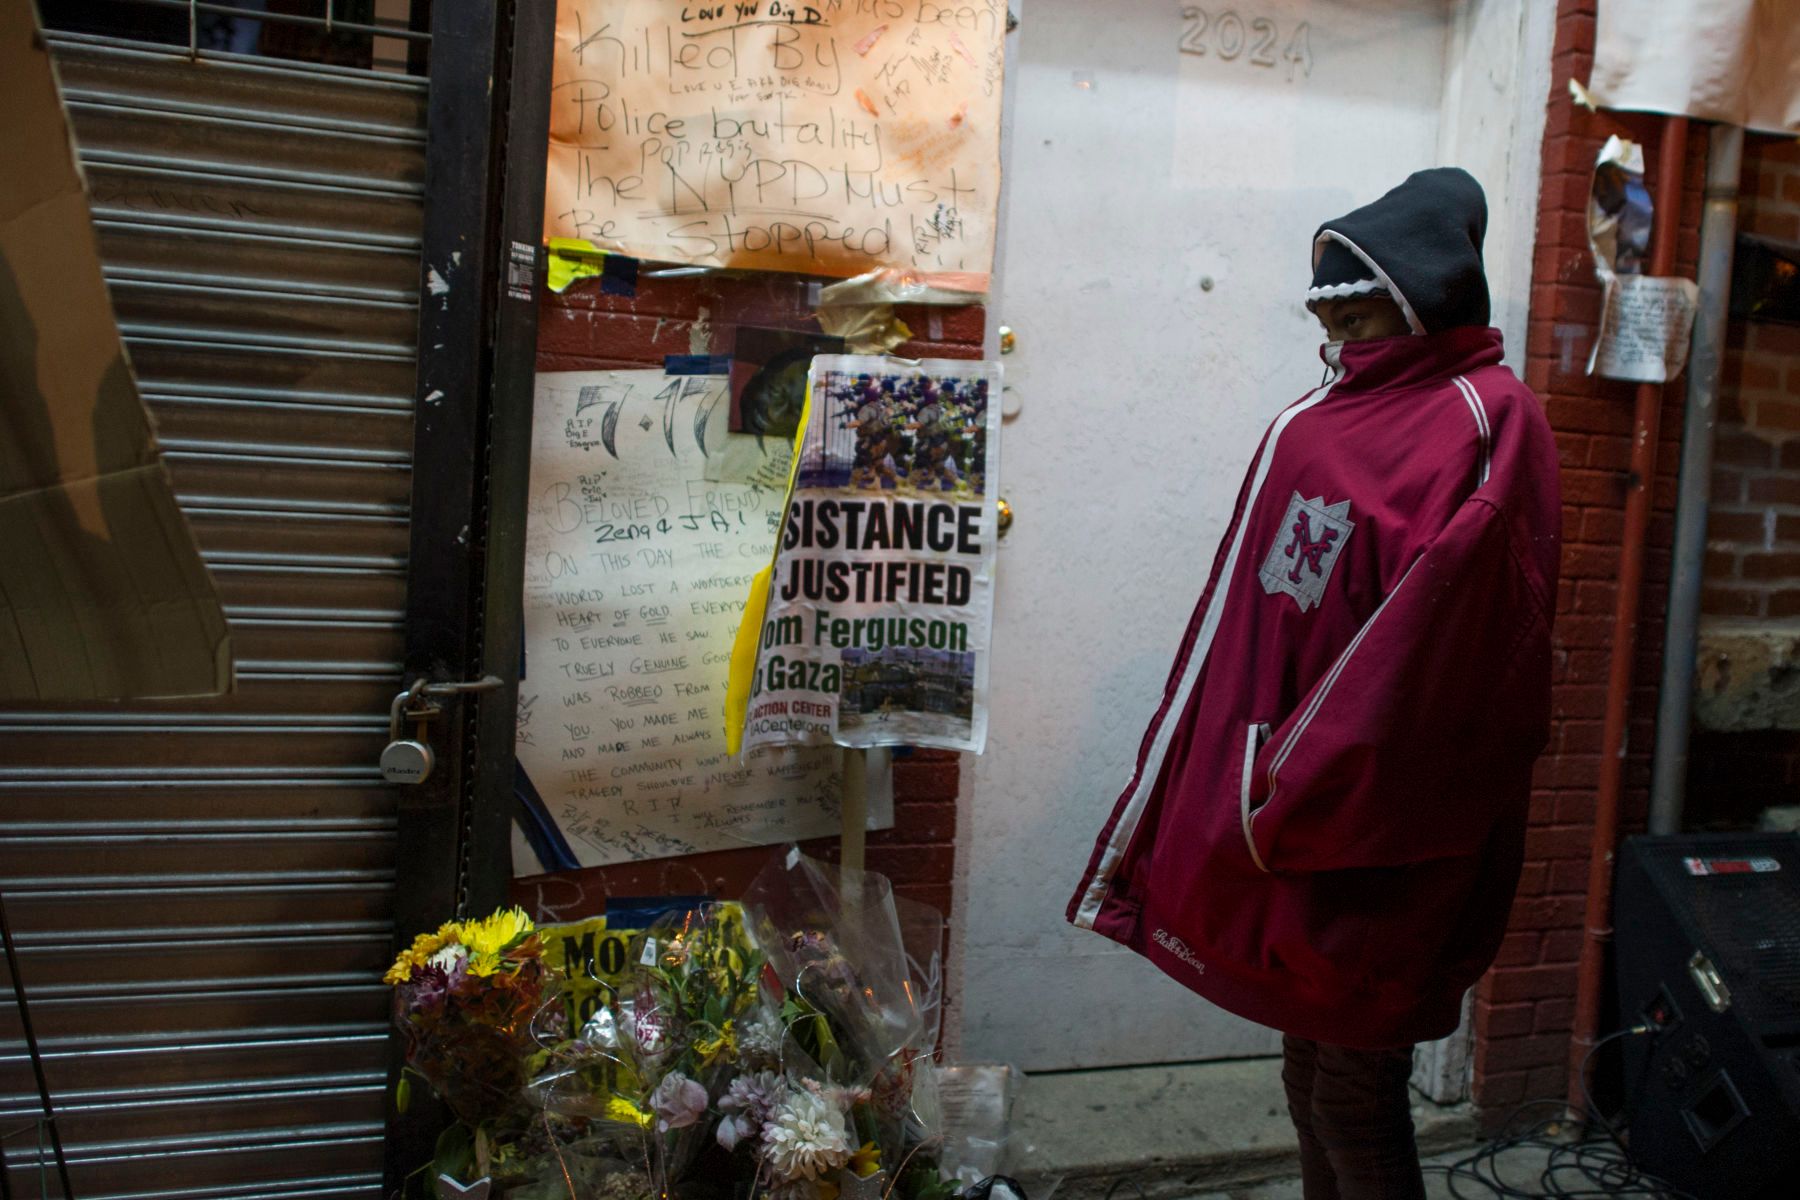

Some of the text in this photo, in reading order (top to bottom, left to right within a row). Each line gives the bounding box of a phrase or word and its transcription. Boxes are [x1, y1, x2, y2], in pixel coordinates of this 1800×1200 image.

[572, 11, 738, 79] Killed
[757, 23, 842, 97] By
[783, 499, 983, 555] SISTANCE
[780, 558, 972, 607] JUSTIFIED
[814, 609, 968, 653] Ferguson
[767, 654, 841, 694] Gaza
